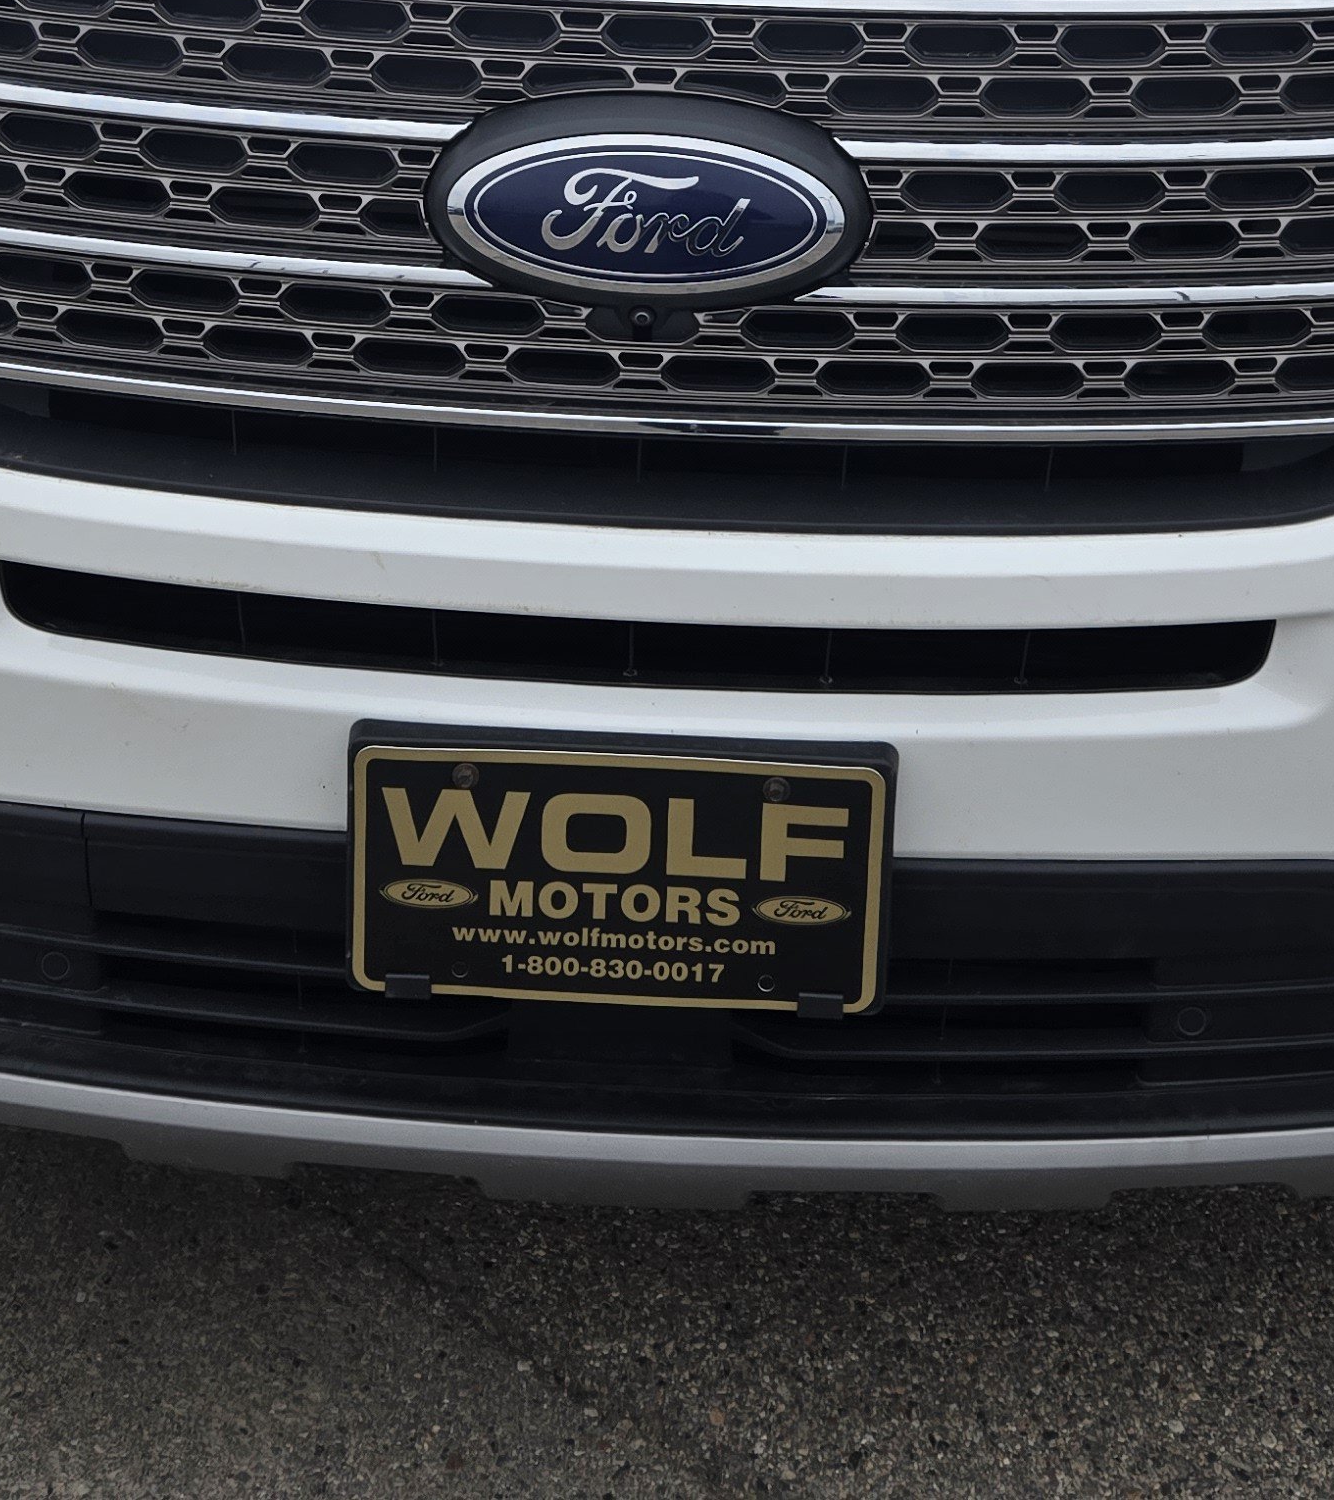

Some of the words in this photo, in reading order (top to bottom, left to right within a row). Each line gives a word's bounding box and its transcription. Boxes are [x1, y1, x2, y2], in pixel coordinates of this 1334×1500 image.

[541, 167, 750, 258] Ford
[381, 787, 850, 882] WOLF
[401, 884, 454, 904] Ford
[489, 880, 741, 926] MOTORS
[774, 902, 828, 921] Ford
[452, 925, 776, 955] www.wolfmotors.com
[501, 954, 725, 984] 1-800-830-0017
